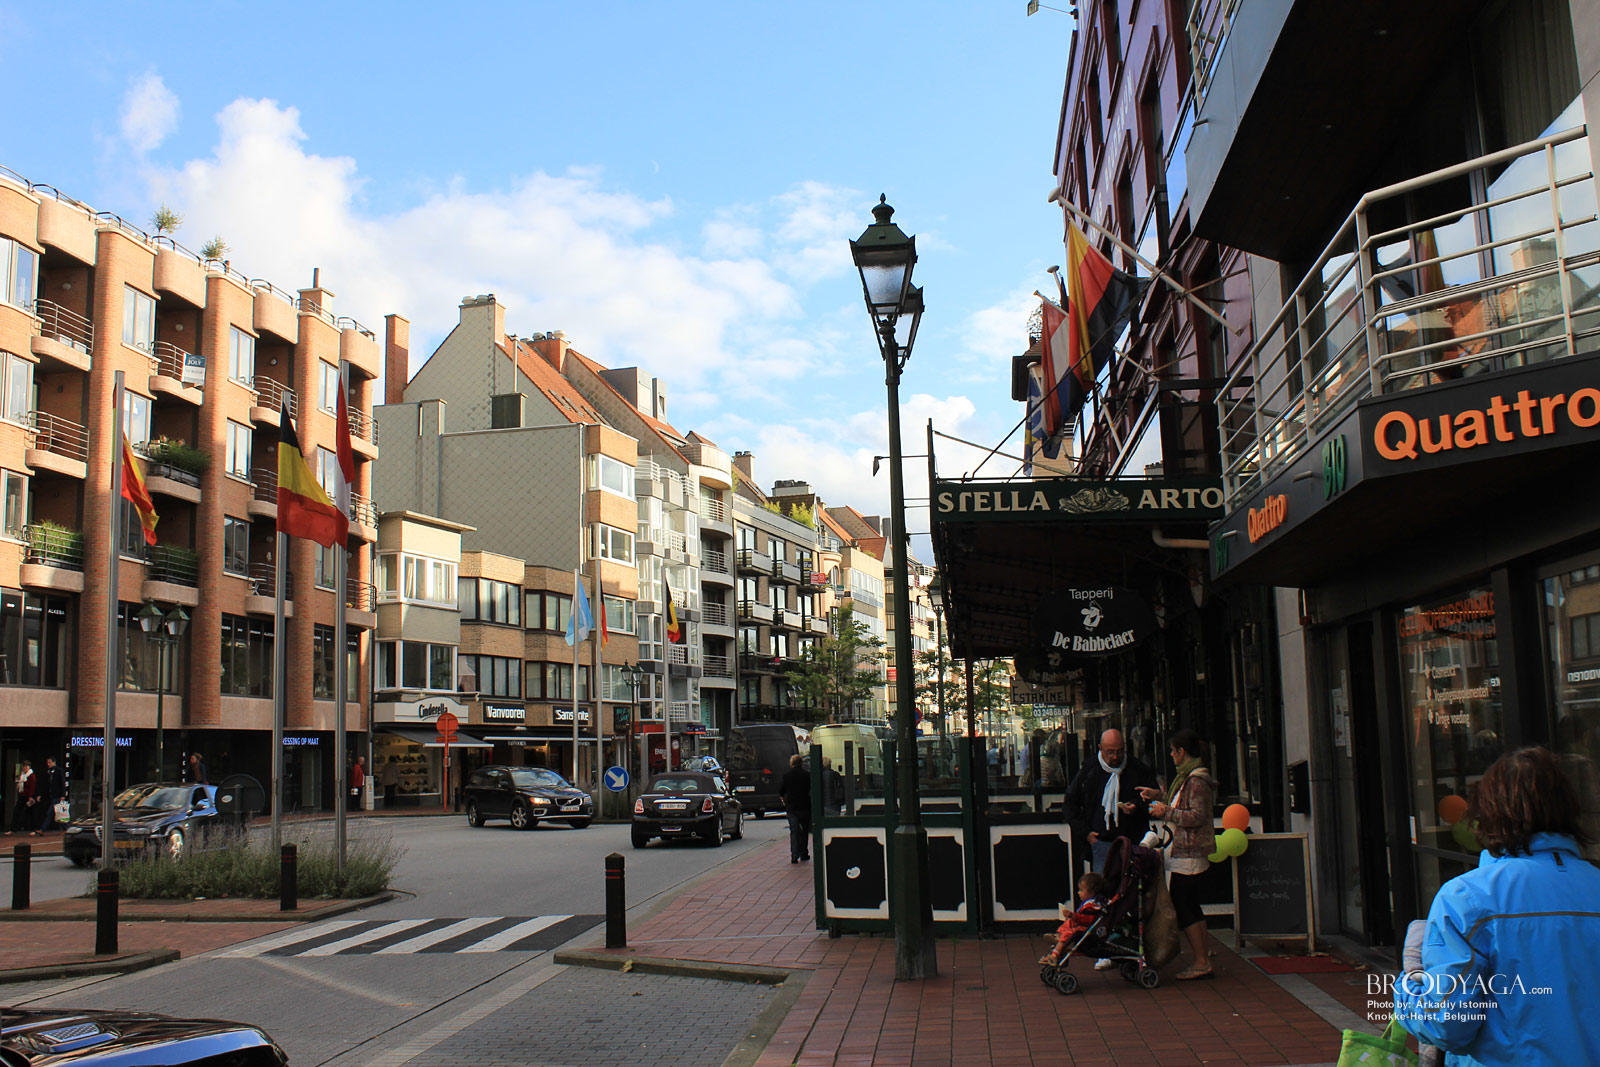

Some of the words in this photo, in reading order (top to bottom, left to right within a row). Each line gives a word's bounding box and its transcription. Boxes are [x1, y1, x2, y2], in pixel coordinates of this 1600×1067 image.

[1373, 388, 1600, 460] Quattro
[937, 490, 1051, 513] STELLA
[1137, 487, 1226, 511] ARTO
[1247, 494, 1287, 543] Quattro
[1068, 587, 1114, 601] Tapperij
[1051, 630, 1070, 648] De
[1071, 629, 1136, 652] Babbelaer
[418, 703, 448, 721] Cinderella
[486, 705, 526, 719] Vanvooren
[555, 709, 589, 721] Samsnite
[71, 737, 105, 747] DRESSING
[115, 737, 133, 747] MAAT
